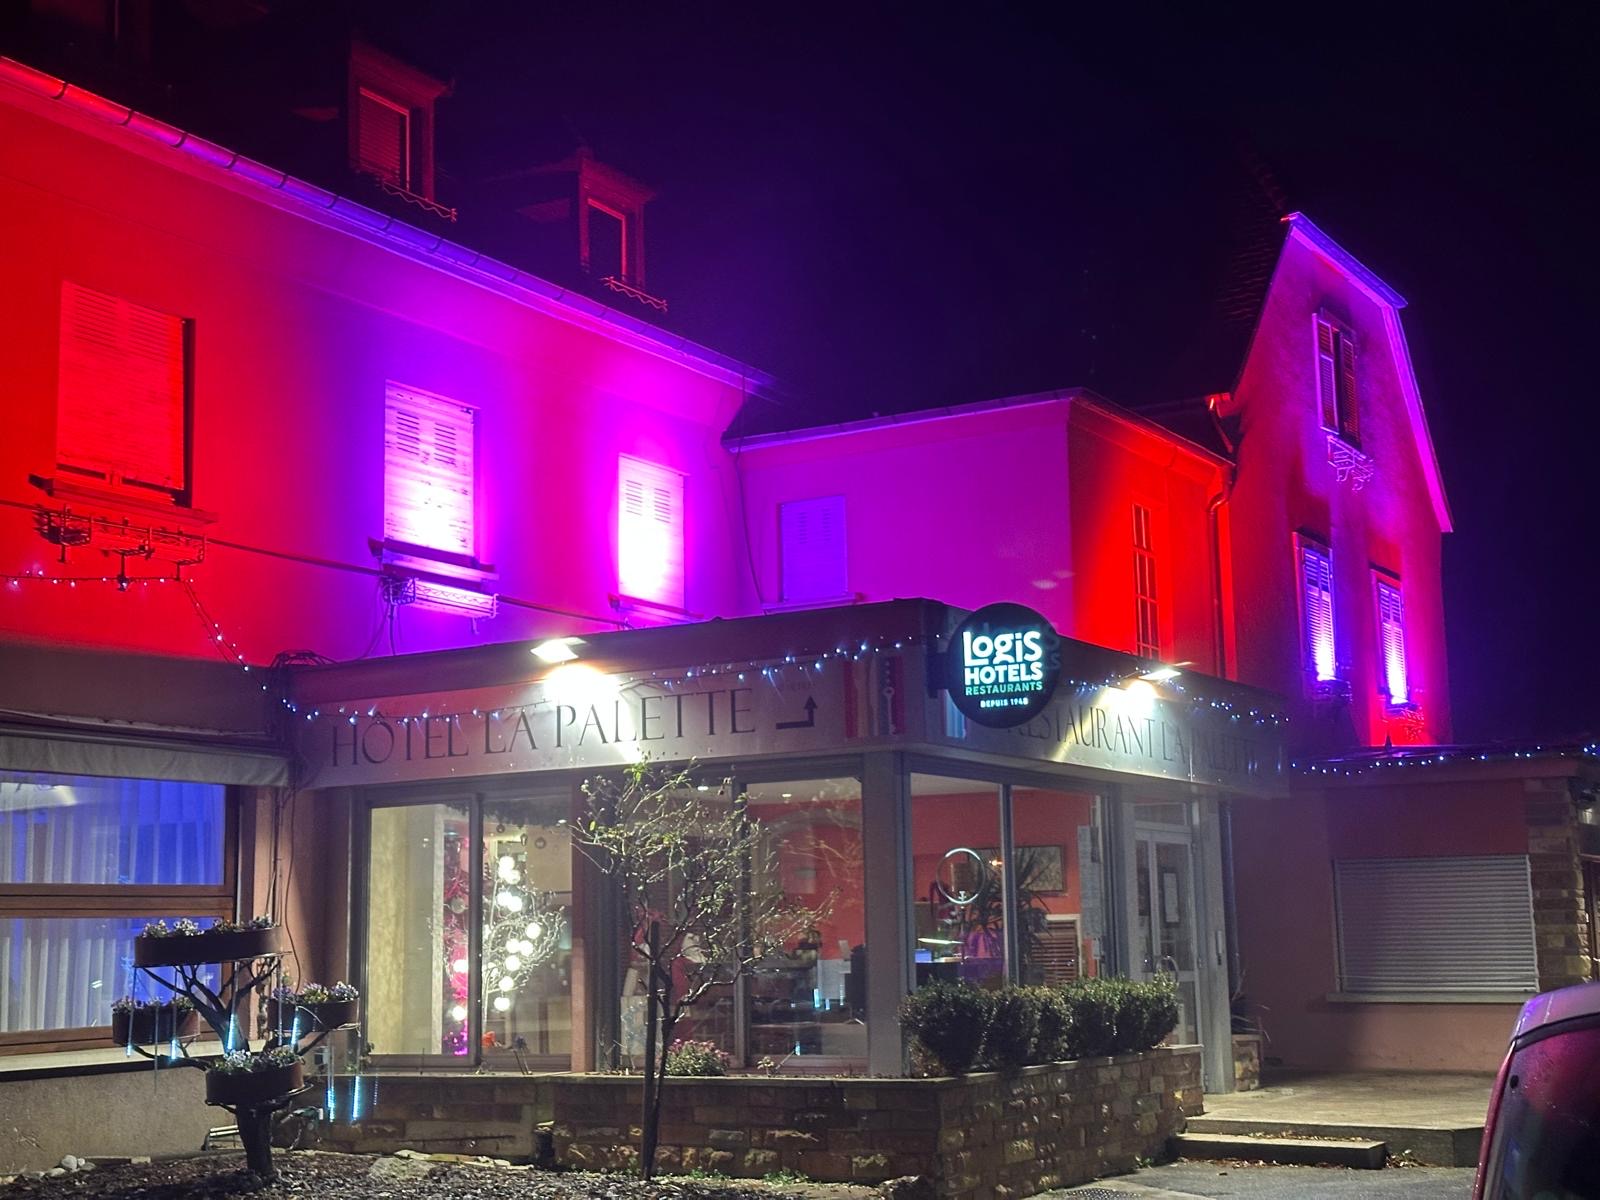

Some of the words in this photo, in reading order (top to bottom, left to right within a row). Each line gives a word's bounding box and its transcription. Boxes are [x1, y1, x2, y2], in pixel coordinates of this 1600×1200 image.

[964, 661, 1043, 686] HOTELS
[965, 681, 1043, 696] RESTAURANTS
[980, 699, 1009, 708] DEPUIS
[332, 710, 469, 767] HÔTEL
[484, 710, 538, 754] LA
[555, 687, 756, 748] PALETTE
[1161, 721, 1187, 765] LA
